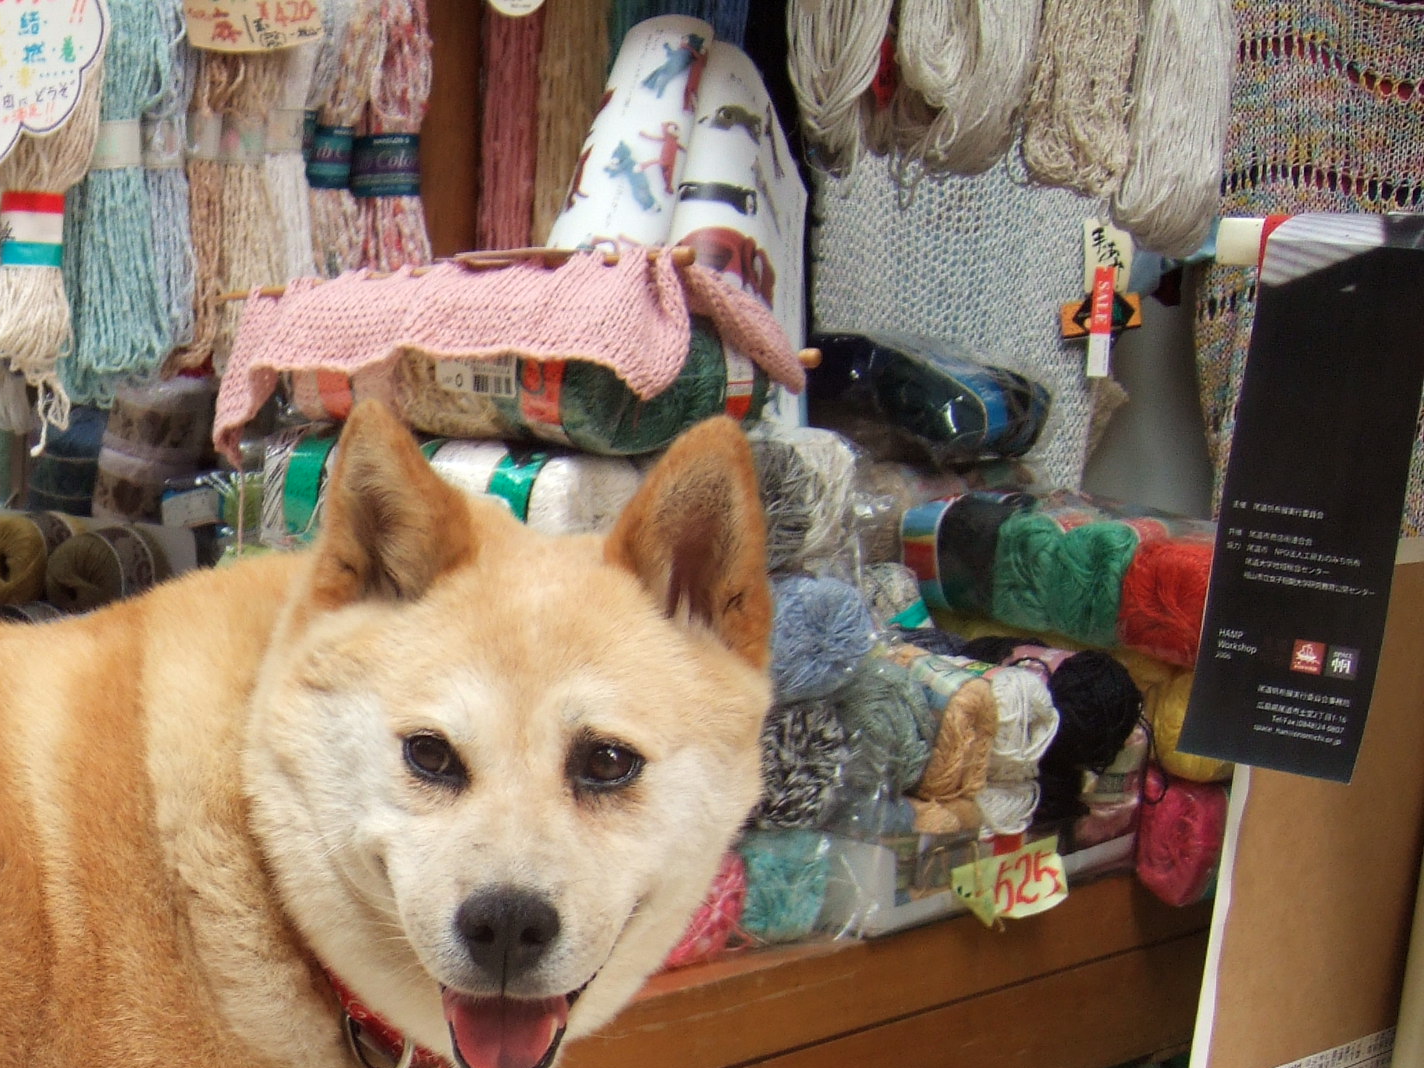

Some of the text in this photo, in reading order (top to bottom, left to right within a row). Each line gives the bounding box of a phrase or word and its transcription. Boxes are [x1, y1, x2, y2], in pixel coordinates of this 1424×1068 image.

[1094, 279, 1111, 326] SALE
[1217, 640, 1258, 655] Workshop
[994, 851, 1063, 914] 525
